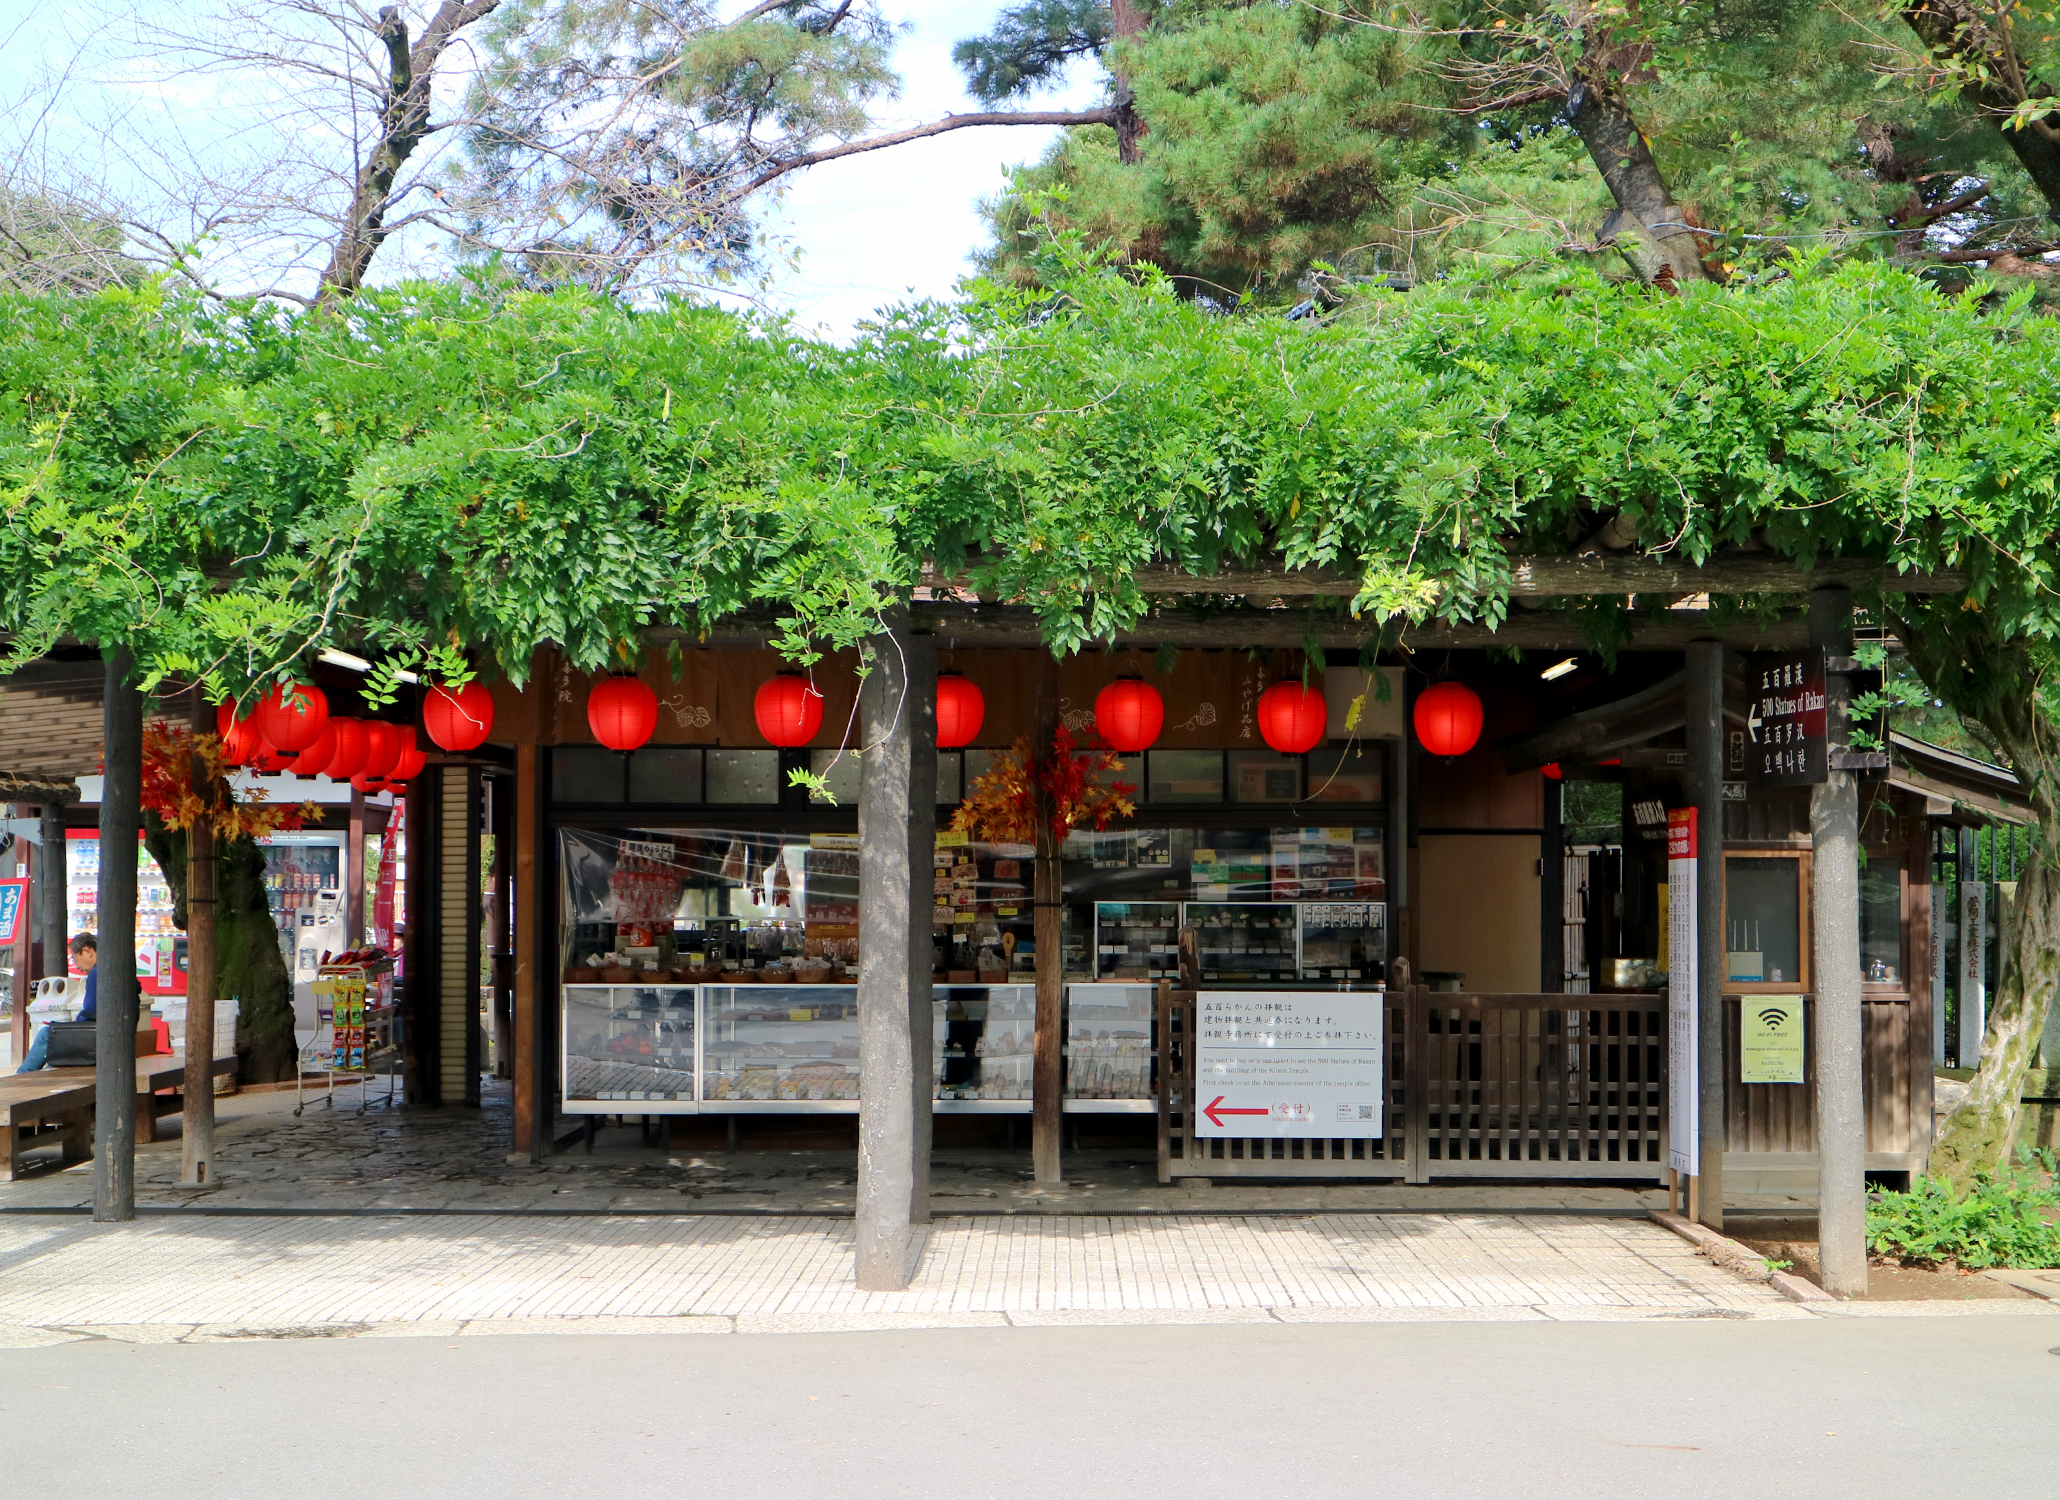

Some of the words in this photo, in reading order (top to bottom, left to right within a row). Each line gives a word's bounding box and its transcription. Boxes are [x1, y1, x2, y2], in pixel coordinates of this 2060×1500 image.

[1762, 662, 1804, 690] 五百羅漢
[1239, 676, 1253, 738] みやげ品店
[1762, 698, 1774, 718] 500
[1775, 696, 1796, 716] Statues
[1797, 692, 1804, 712] of
[1805, 691, 1825, 711] Rakan
[1764, 723, 1805, 745] 五百罗汉
[1764, 748, 1806, 774] 오백나한
[1230, 873, 1263, 881] COLOR
[1, 887, 17, 937] あま酒
[1204, 1002, 1293, 1012] 五百らかんの拝観は
[1237, 1057, 1247, 1066] buy
[1248, 1057, 1260, 1066] only
